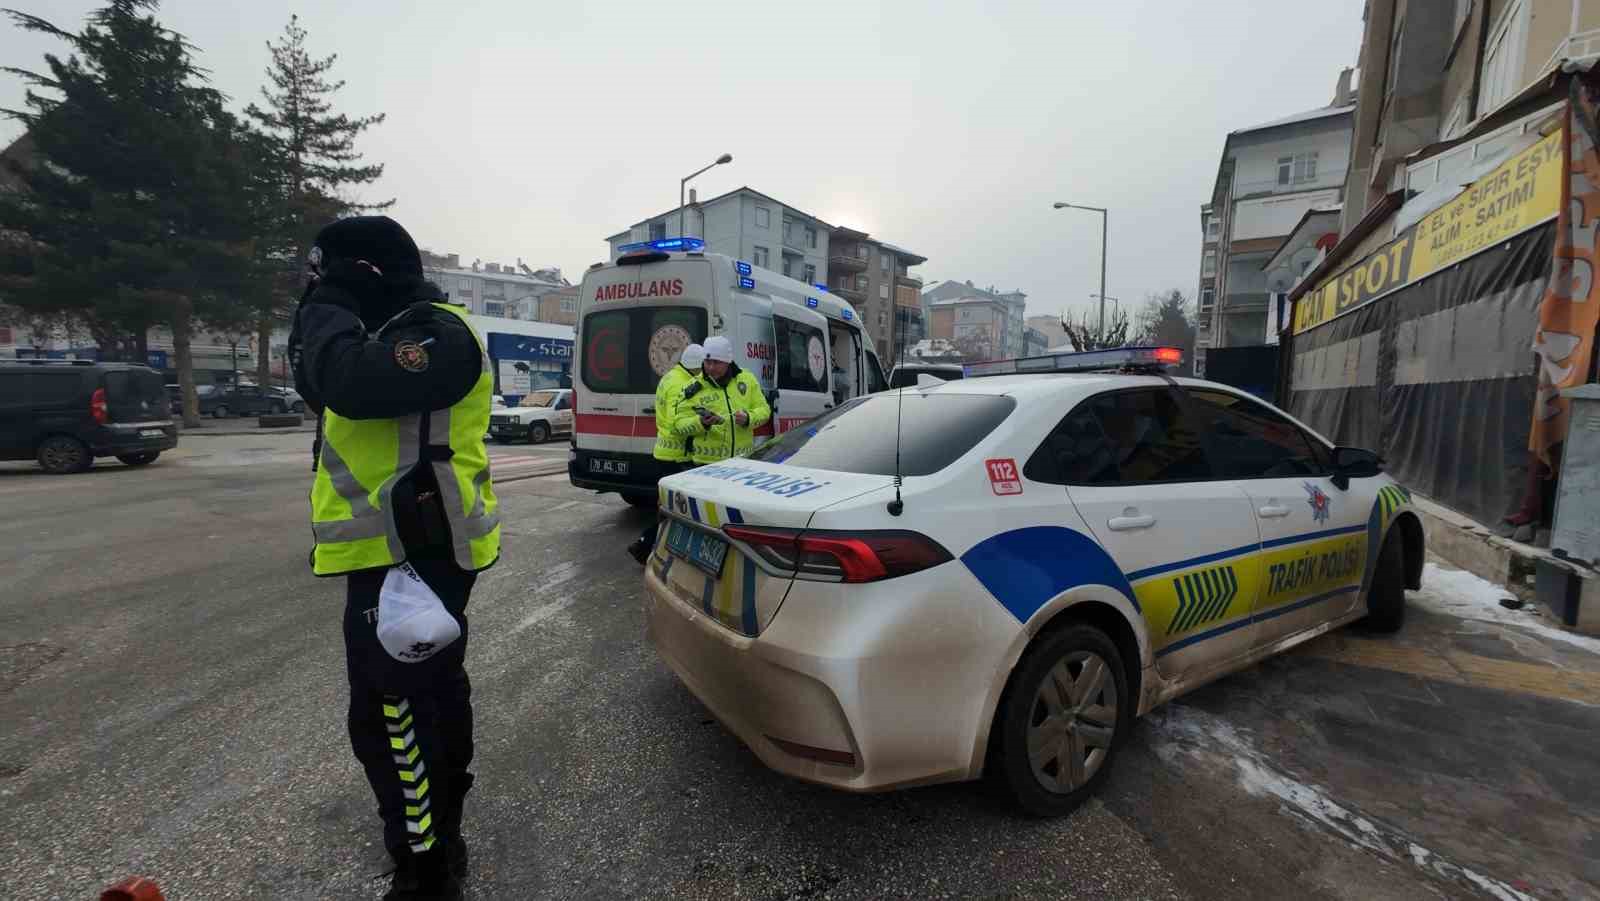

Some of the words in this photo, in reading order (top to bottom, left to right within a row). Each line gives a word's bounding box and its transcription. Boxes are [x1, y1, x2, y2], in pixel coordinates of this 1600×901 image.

[1431, 212, 1445, 232] EL
[1469, 168, 1511, 210] SIFIR
[1431, 221, 1462, 250] ALIM
[594, 278, 684, 302] AMBULANS
[1341, 239, 1409, 308] SPOT
[991, 462, 1017, 480] 112
[1265, 549, 1316, 598] TRAFİK
